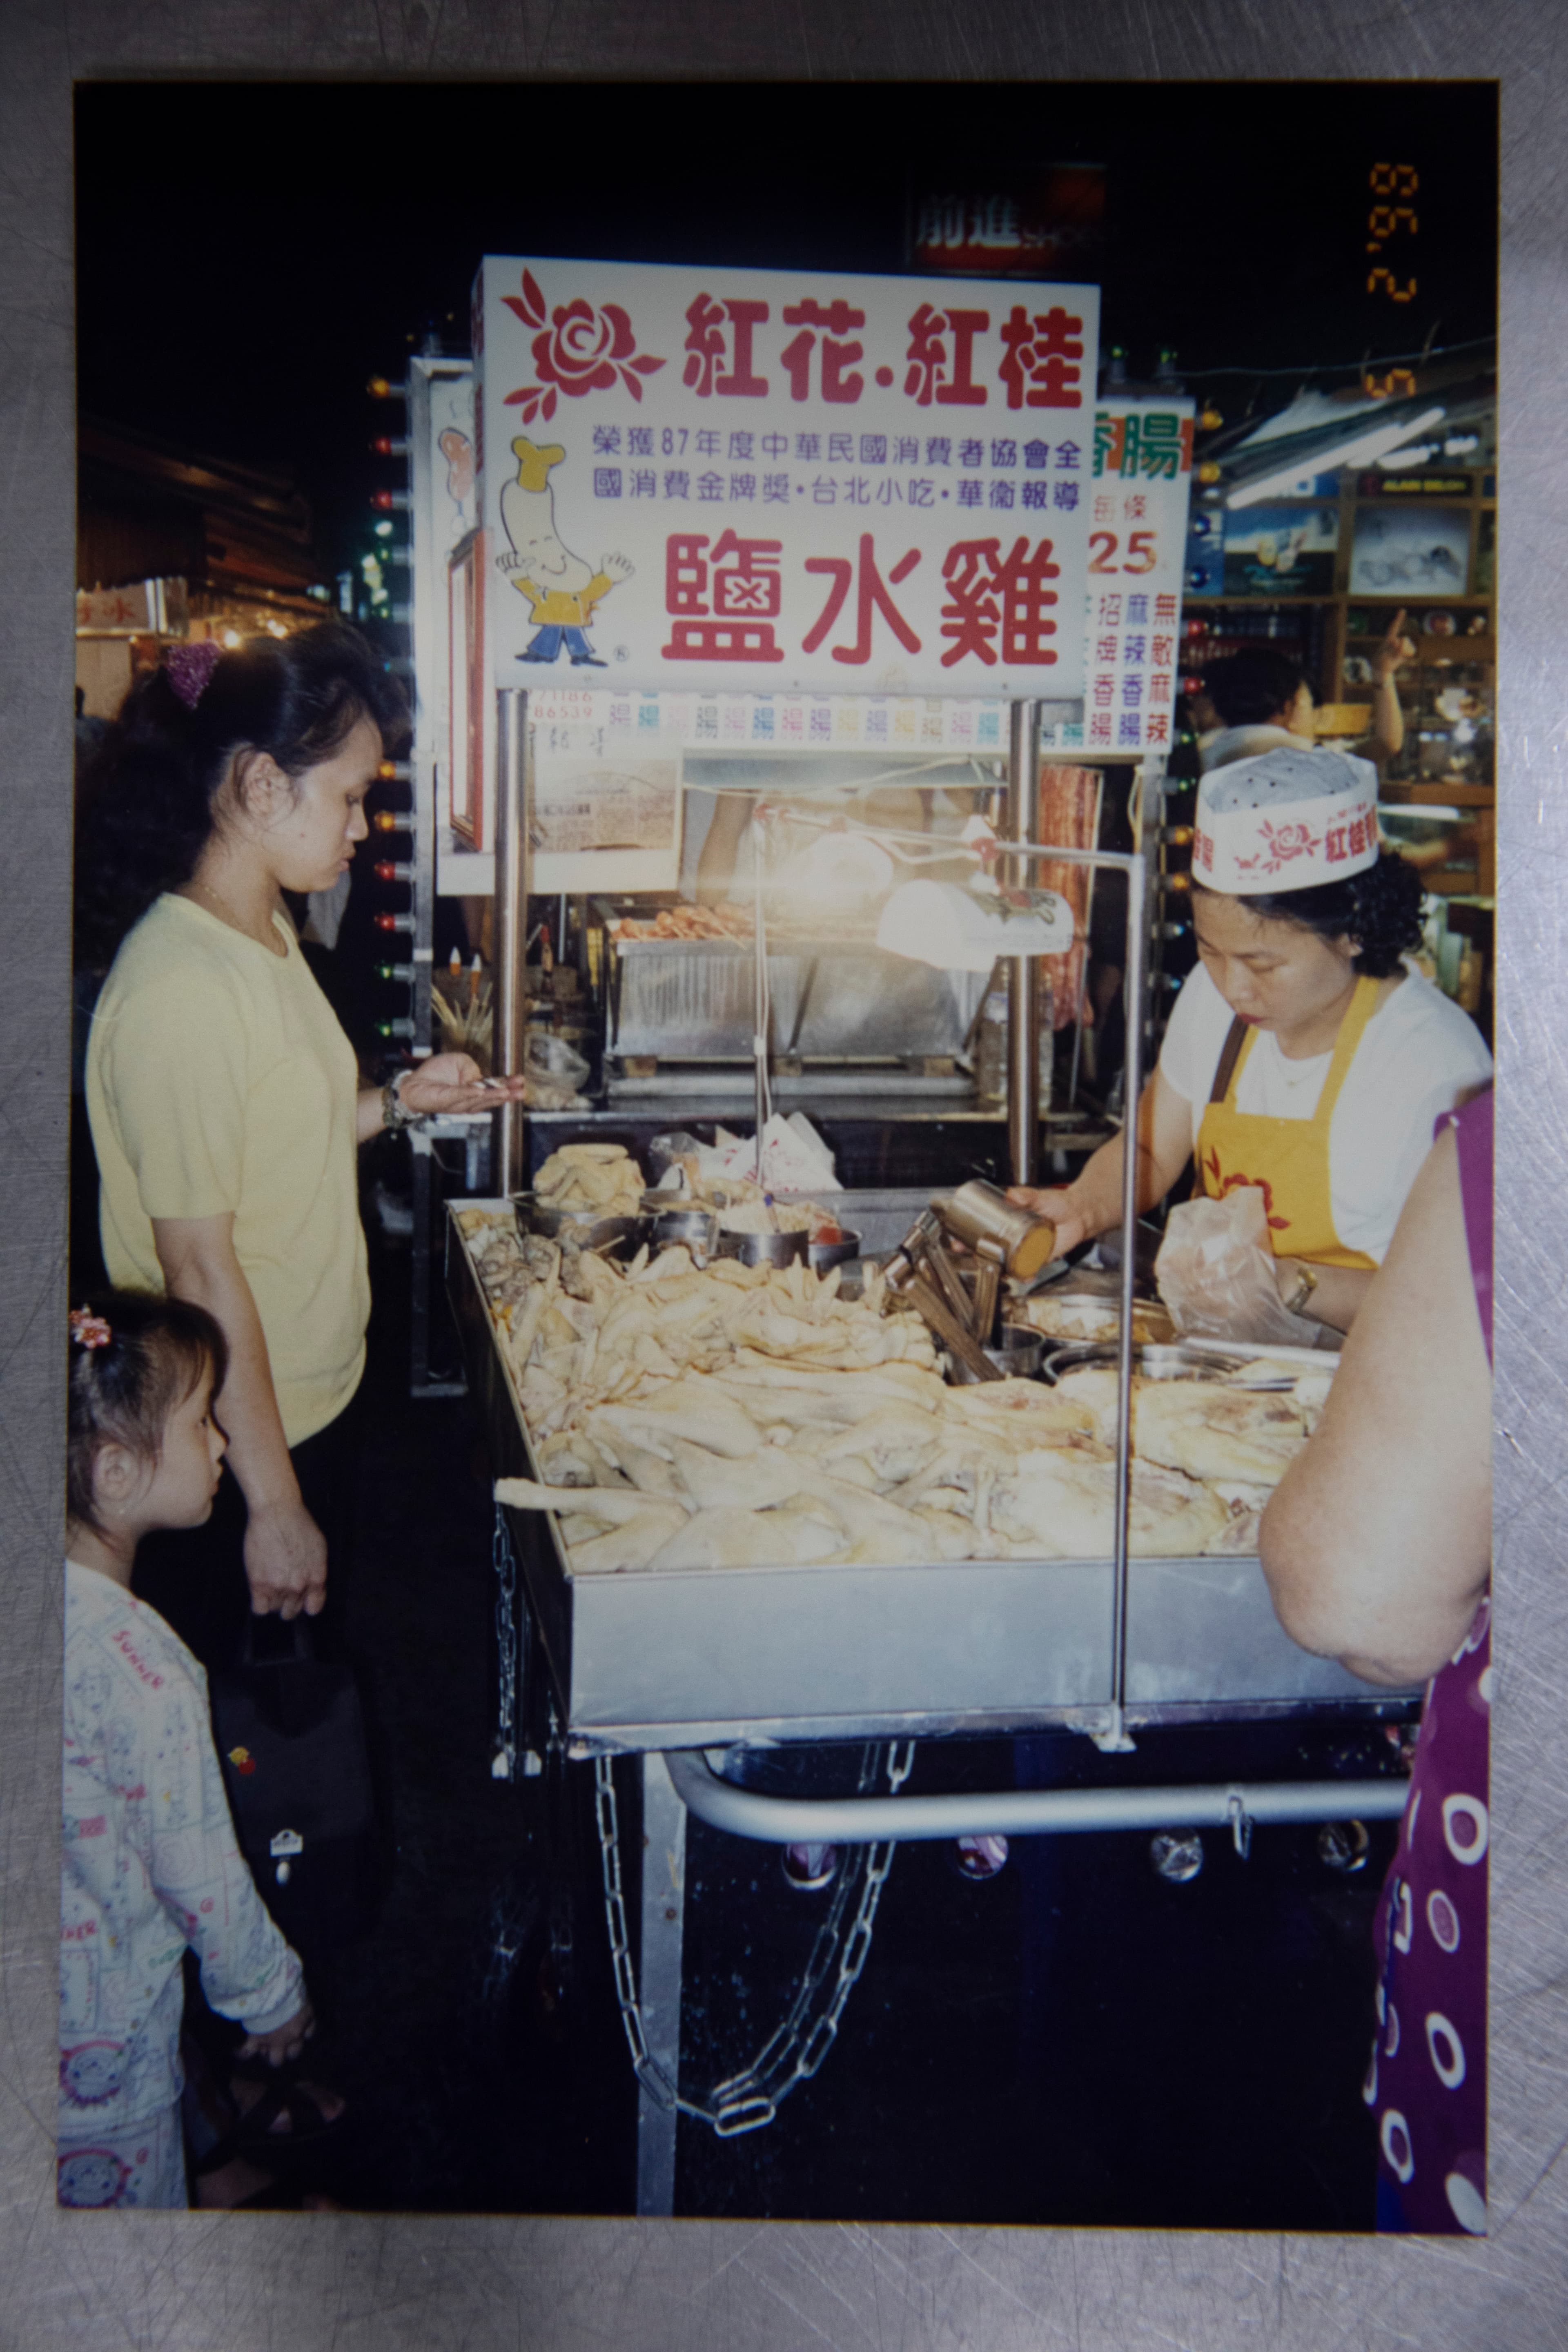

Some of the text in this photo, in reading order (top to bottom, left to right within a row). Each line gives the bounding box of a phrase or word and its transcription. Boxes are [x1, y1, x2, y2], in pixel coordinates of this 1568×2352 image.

[914, 194, 1022, 248] 前進
[1088, 531, 1158, 575] 25
[661, 529, 1060, 667] 鹽水雞
